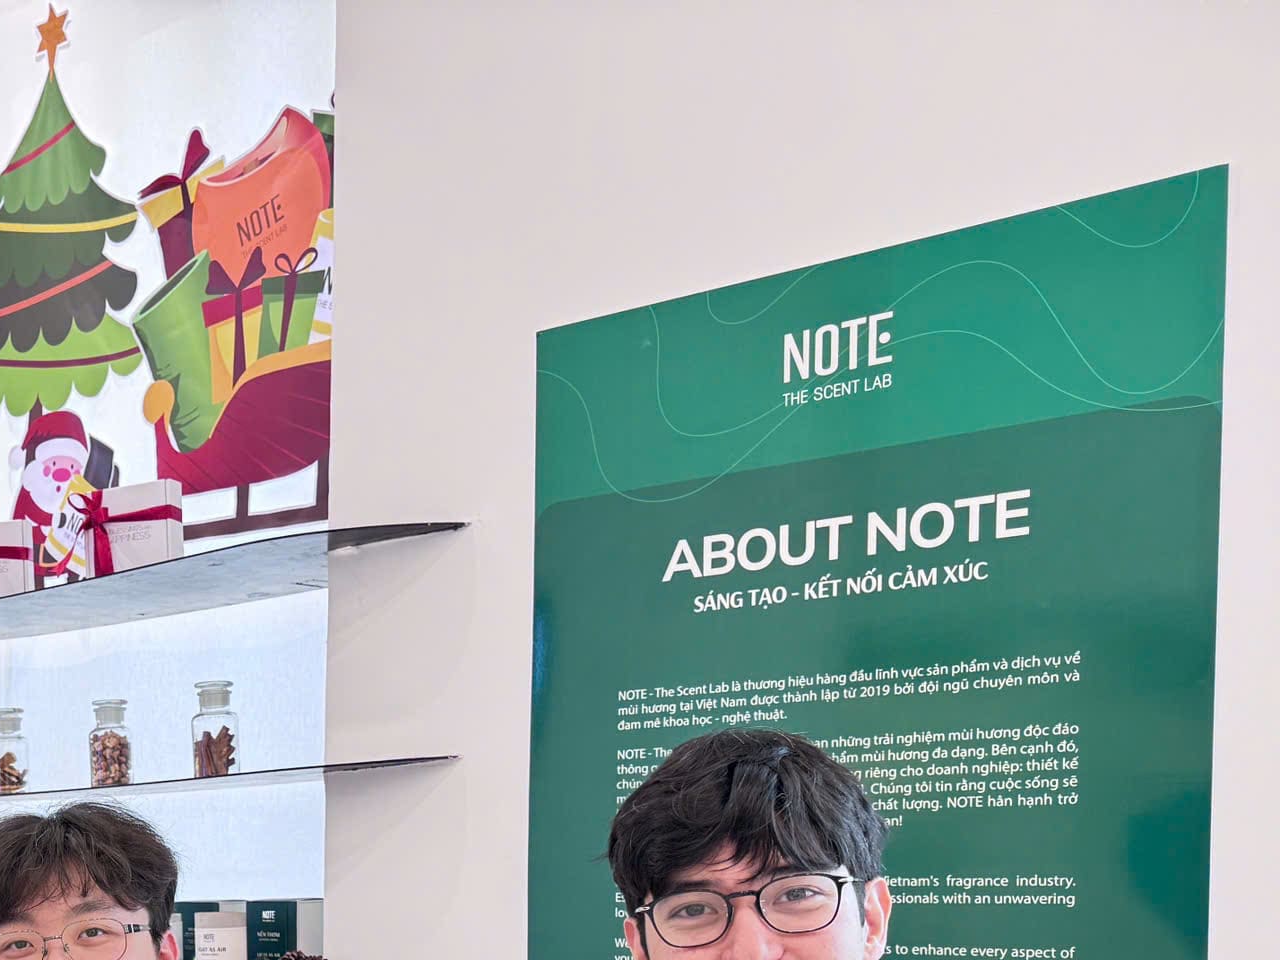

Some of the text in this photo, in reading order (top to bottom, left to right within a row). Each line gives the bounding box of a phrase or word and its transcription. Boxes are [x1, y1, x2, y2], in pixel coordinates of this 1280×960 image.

[236, 194, 285, 247] NOTE
[783, 311, 894, 383] NOTE
[783, 374, 892, 407] THE SCENT LAB
[662, 489, 1031, 582] ABOUT NOTE
[693, 558, 989, 612] SÁNG TẠO KẾT NỐI CẢM XÚC
[618, 651, 1081, 701] NOTE The Scent Lab là thương hiệu hàng đầu lĩnh vực sản phẩm và dịch vụ về
[618, 671, 1080, 716] mùi hương tại Việt Nam được thành lập từ 2019 bởi đội ngũ chuyên môn và
[618, 709, 787, 730] đam mê khoa học nghệ thuật.
[831, 734, 871, 749] những
[874, 733, 893, 745] trải
[897, 731, 945, 747] nghiệm
[949, 729, 973, 741] mùi
[976, 728, 1020, 741] hương
[1024, 725, 1049, 738] độc
[1052, 723, 1079, 735] đáo
[617, 749, 646, 760] NOTE
[832, 740, 1079, 763] hẩm mùi hương đa dạng. Bên cạnh đó,
[865, 765, 897, 780] riêng
[900, 766, 923, 777] cho
[927, 764, 968, 776] doanh
[972, 761, 1023, 776] nghiệp:
[1027, 758, 1058, 771] thiết
[1063, 756, 1079, 770] kế
[616, 778, 643, 789] chún
[871, 781, 912, 796] Chúng
[916, 780, 931, 792] tôi
[936, 780, 953, 792] tin
[956, 778, 986, 793] rằng
[989, 777, 1021, 790] cuộc
[1025, 774, 1058, 789] sống
[1063, 776, 1078, 787] sẽ
[872, 792, 1079, 812] chất lượng. NOTE hân hạnh trở
[884, 875, 1076, 889] ietnam's fragrance industry.
[891, 892, 1075, 908] ssionals with an unwavering
[262, 911, 276, 919] NOTE
[896, 944, 908, 955] to
[912, 944, 967, 956] enhance
[971, 948, 1007, 960] every
[1011, 947, 1056, 960] aspect
[1060, 947, 1075, 959] of
